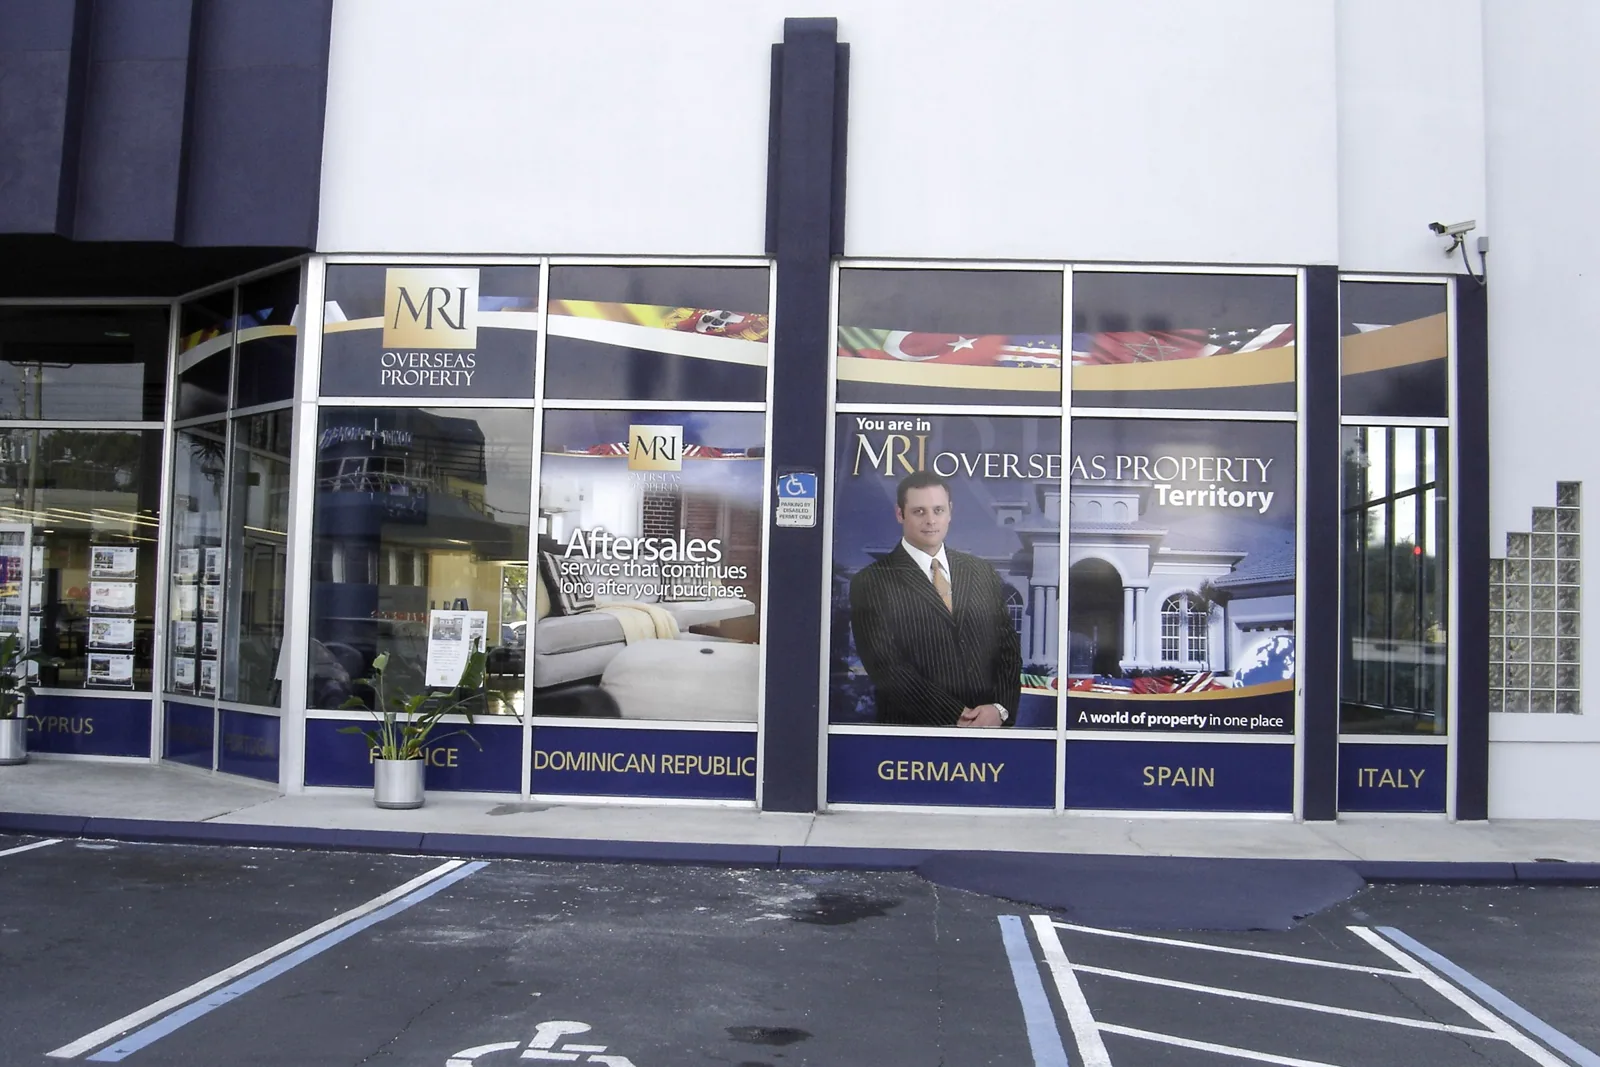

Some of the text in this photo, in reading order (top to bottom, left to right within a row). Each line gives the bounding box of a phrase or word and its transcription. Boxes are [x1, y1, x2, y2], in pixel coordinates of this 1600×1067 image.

[392, 286, 469, 330] MRI
[381, 352, 476, 369] OVERSEAS
[381, 369, 475, 386] PROPERTY
[856, 417, 931, 431] You are in
[634, 435, 676, 460] MRI
[852, 434, 1274, 483] MRI OVERSEAS PROPERTY
[1154, 484, 1274, 514] Territory
[564, 527, 721, 562] Aftersales
[561, 559, 747, 580] service that continues
[560, 578, 747, 599] long after your purchase.
[1079, 711, 1284, 729] A world of property in one place
[534, 750, 755, 777] DOMINICAN REPUBLIC
[877, 760, 1005, 783] GERMANY
[1142, 765, 1215, 788] SPAIN
[1358, 768, 1425, 789] ITALY
